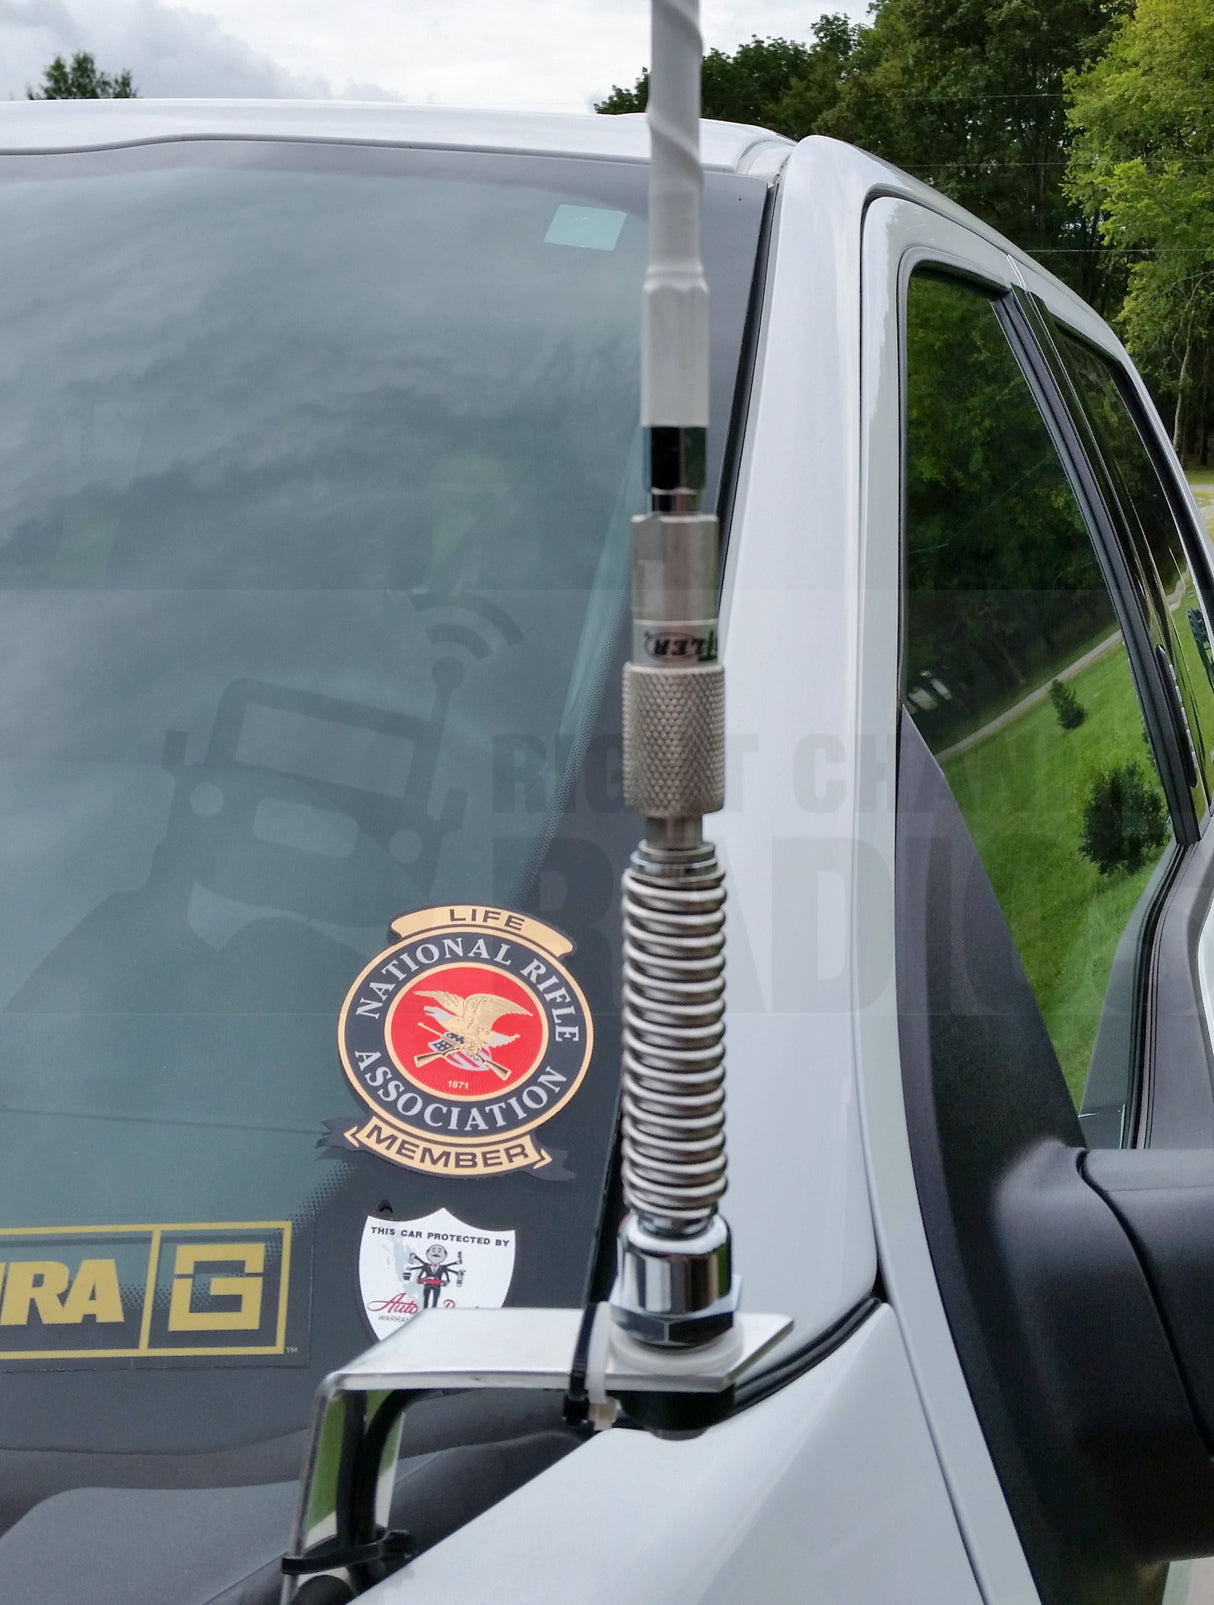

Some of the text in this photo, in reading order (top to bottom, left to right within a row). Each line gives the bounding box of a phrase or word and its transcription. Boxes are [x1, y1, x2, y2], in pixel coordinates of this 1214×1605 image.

[449, 908, 526, 931] LIFE
[356, 937, 580, 1043] NATIONAL RIFLE
[354, 1049, 567, 1131] ASSOCIATION
[448, 1080, 469, 1090] 1871
[366, 1124, 529, 1169] MEMBER
[371, 1226, 510, 1247] THIS CAR PROTECTED BY
[0, 1243, 265, 1331] RA G
[367, 1292, 418, 1315] Auto
